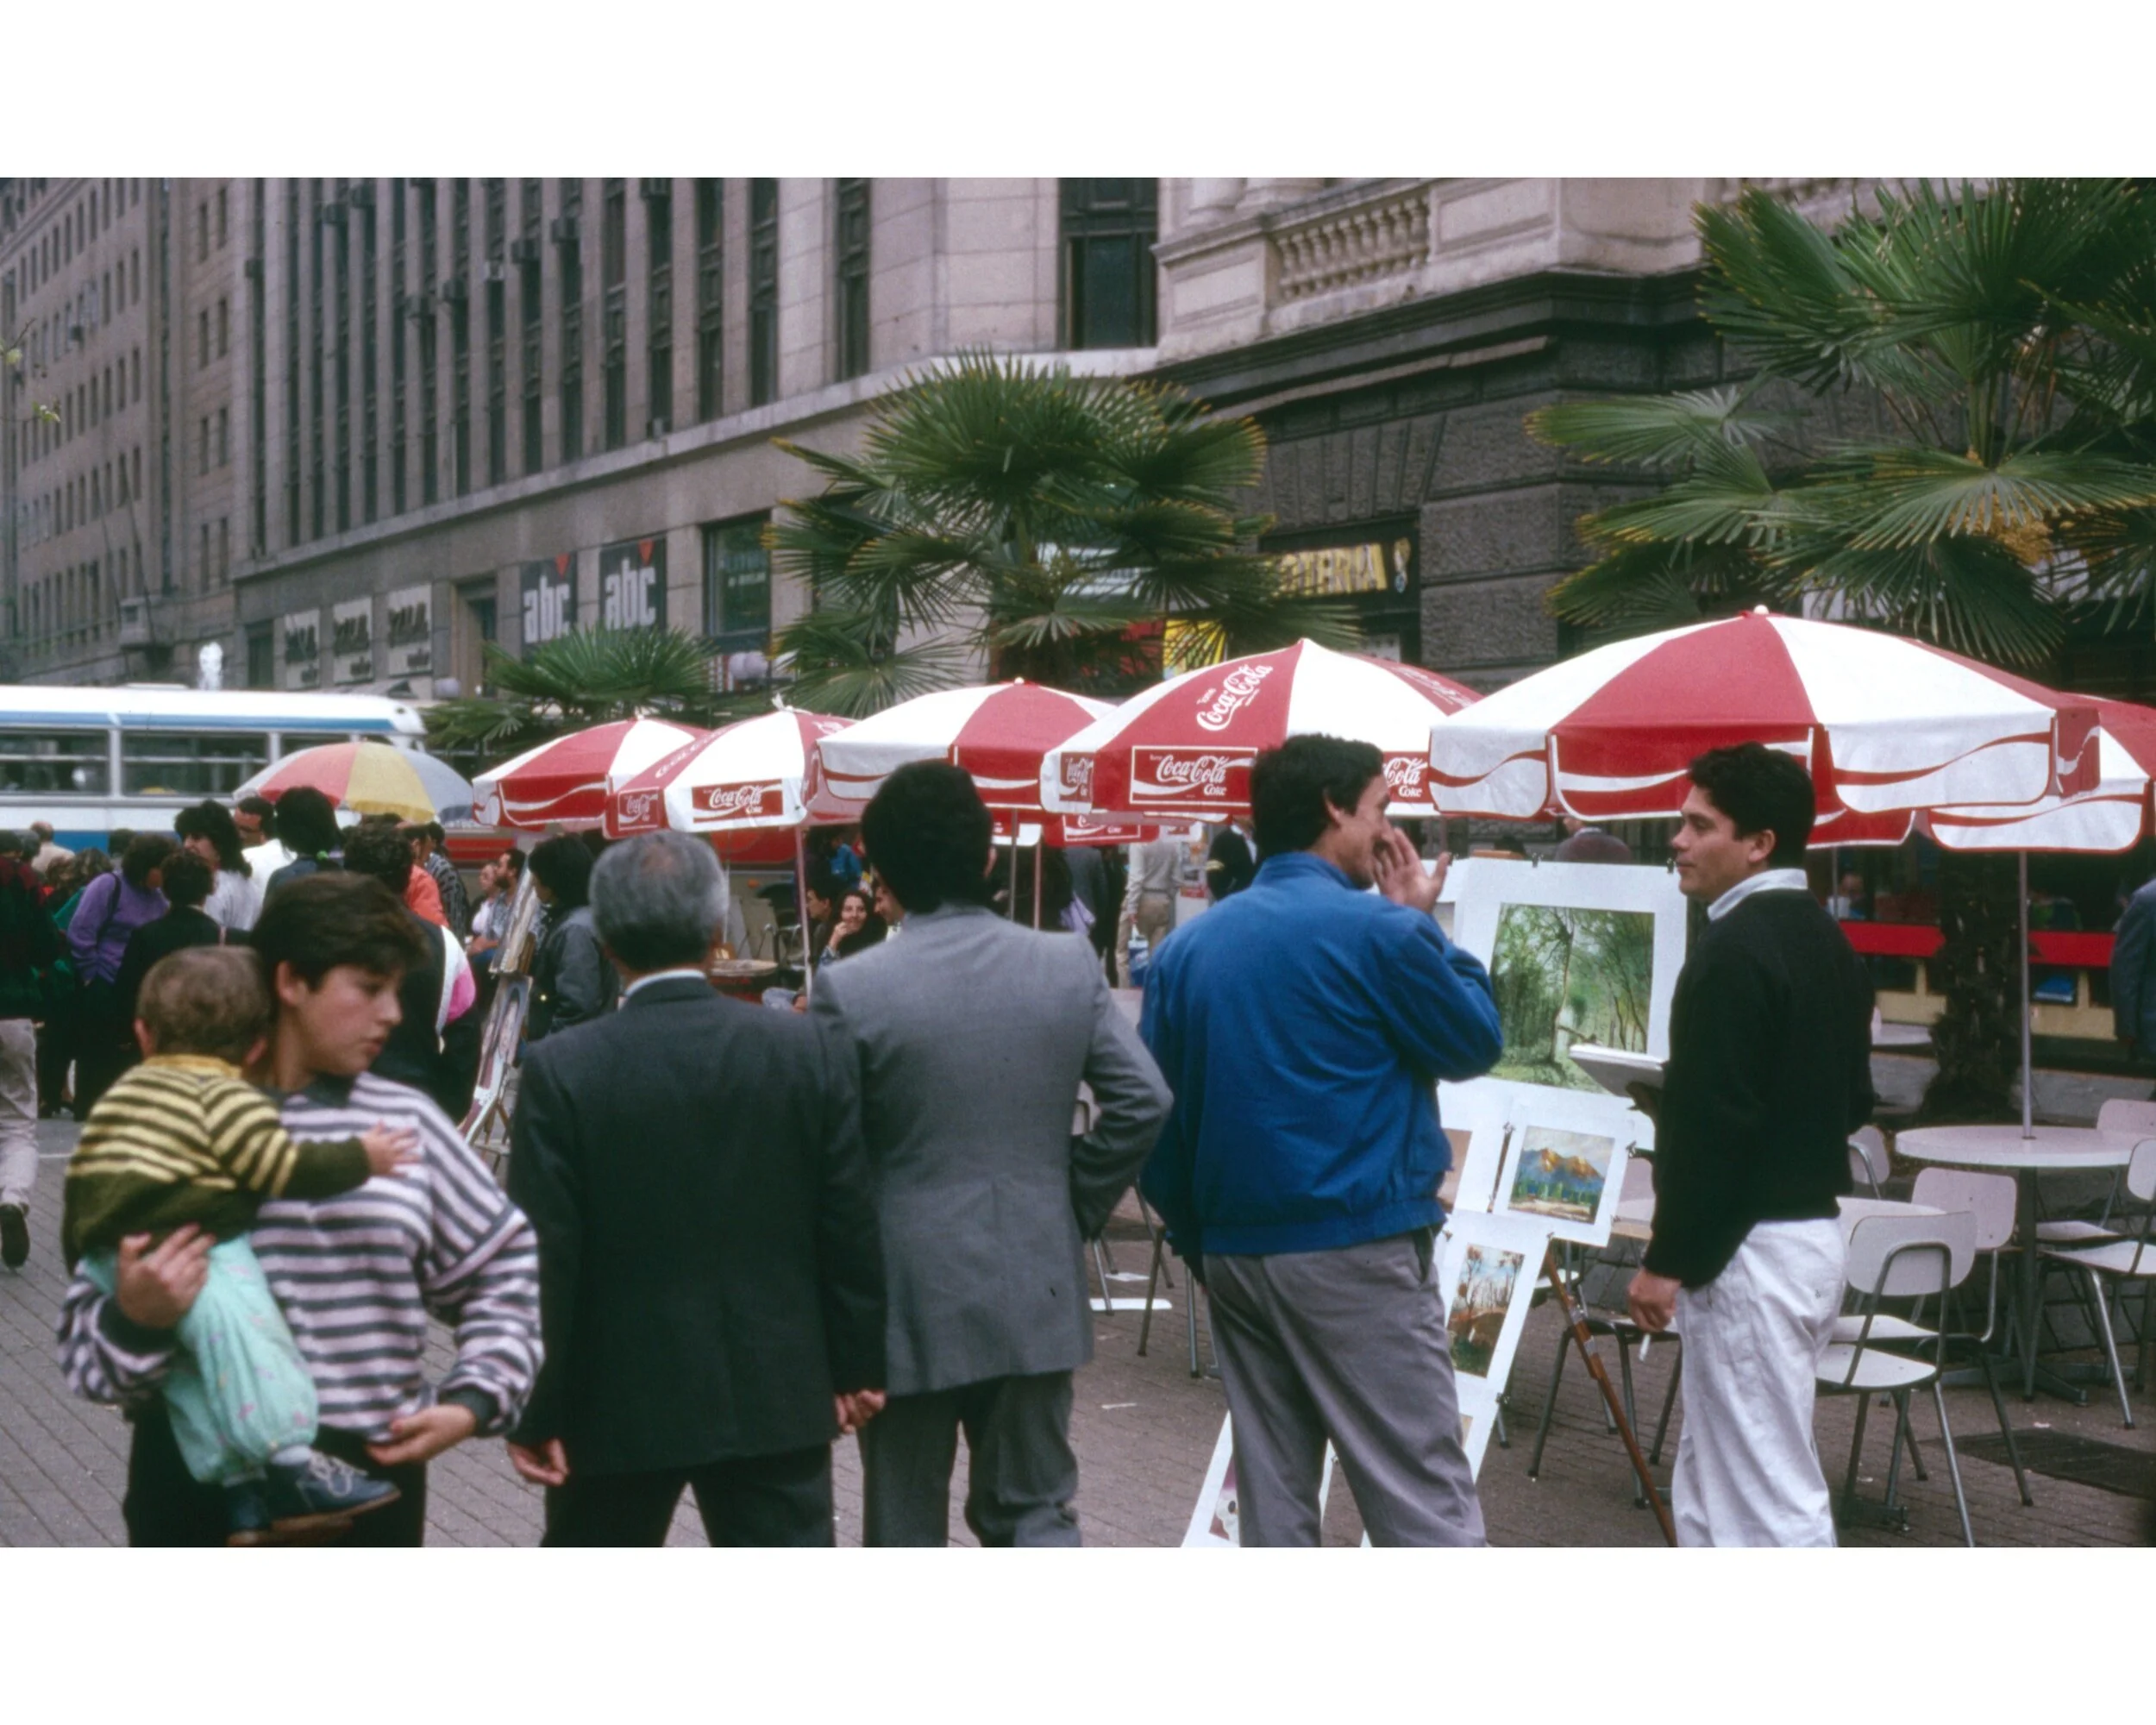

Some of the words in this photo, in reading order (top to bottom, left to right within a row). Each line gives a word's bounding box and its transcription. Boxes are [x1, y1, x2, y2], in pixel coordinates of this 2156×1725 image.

[1276, 543, 1388, 595] OTERIA
[523, 575, 570, 643] abc
[605, 558, 656, 631] abc
[1196, 664, 1273, 731] Coca-Cola
[1156, 754, 1228, 783] Coca-Cola
[709, 786, 763, 808] Coca-Cola
[1204, 783, 1227, 796] Coke
[1399, 784, 1423, 798] Coke
